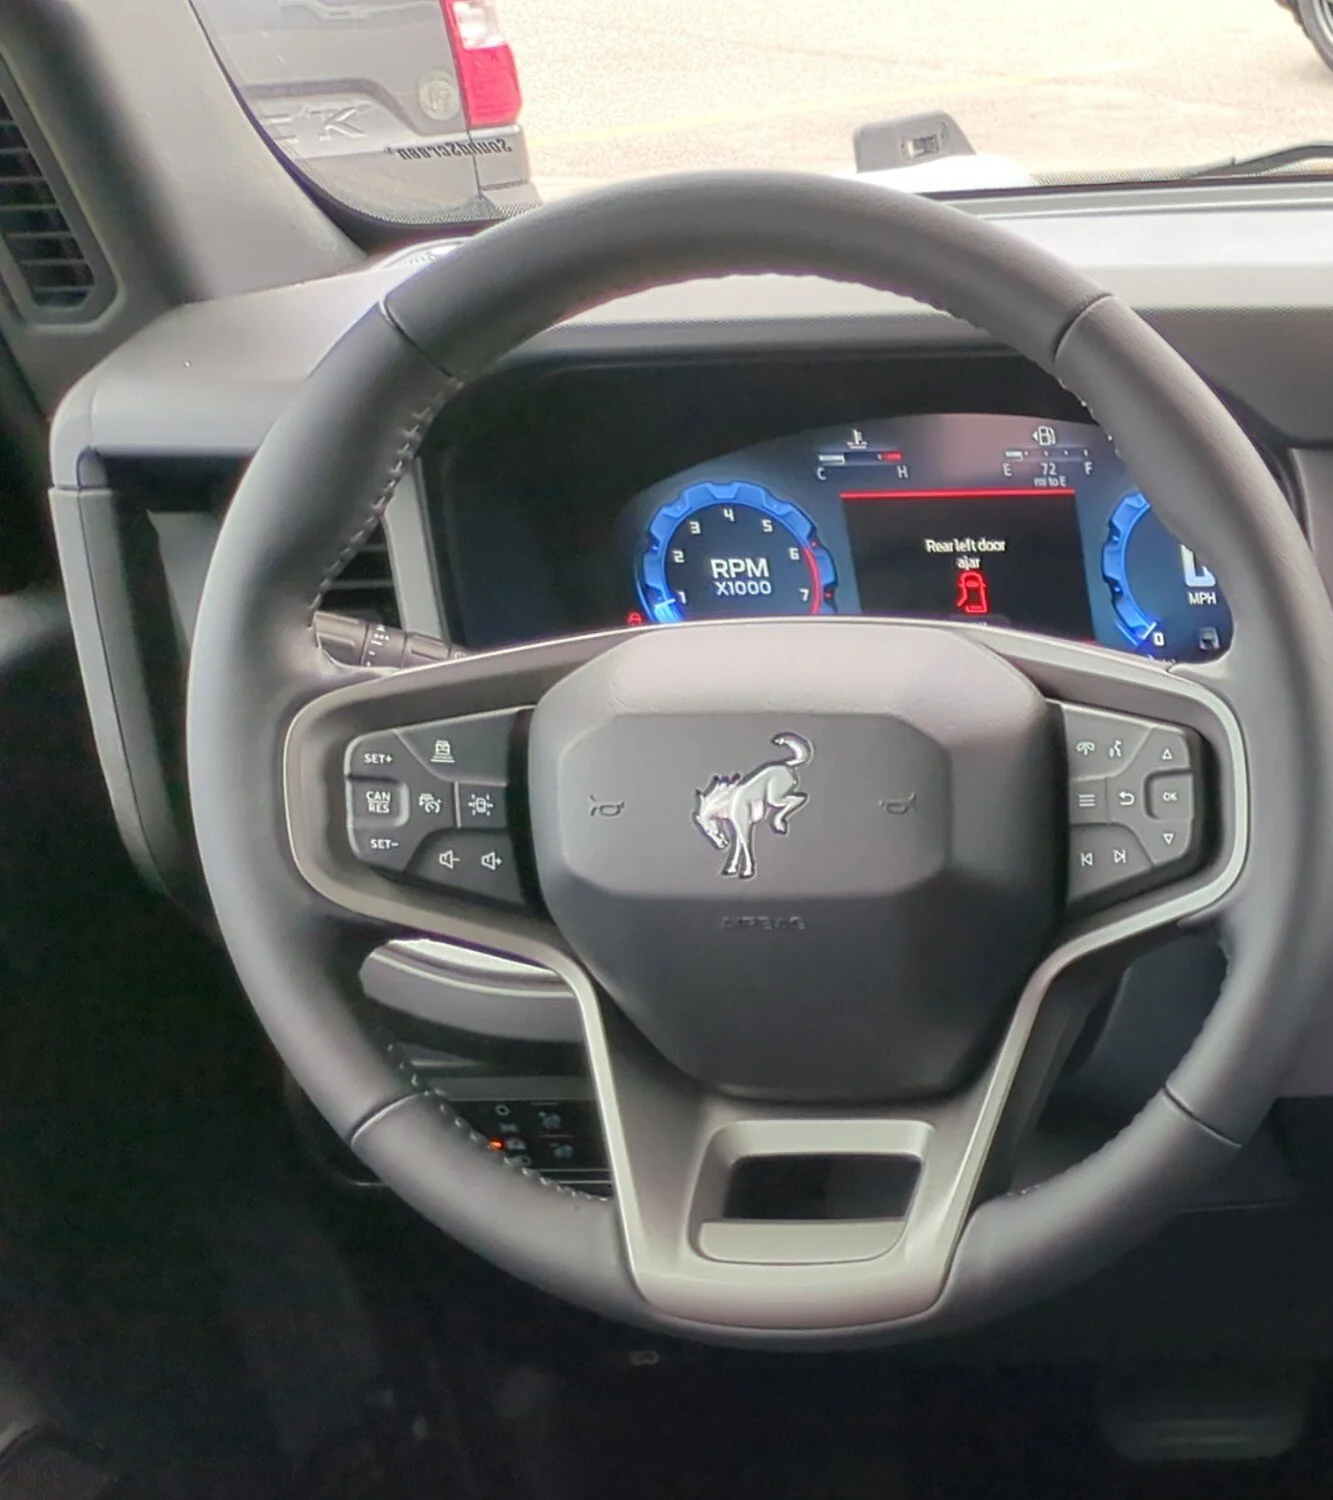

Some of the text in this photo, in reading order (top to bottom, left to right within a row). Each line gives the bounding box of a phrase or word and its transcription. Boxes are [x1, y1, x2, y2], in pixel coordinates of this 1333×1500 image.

[817, 468, 826, 480] C
[897, 467, 908, 479] H
[1003, 464, 1012, 477] E
[1040, 463, 1057, 476] 72
[1085, 462, 1092, 475] F
[1034, 475, 1067, 486] mi to E
[723, 508, 734, 521] 4
[689, 521, 701, 534] 3
[762, 519, 773, 532] 5
[925, 538, 1006, 552] Rear left door
[673, 550, 685, 563] 2
[789, 548, 800, 560] 6
[710, 558, 770, 579] RPM
[957, 556, 980, 571] ajar
[715, 581, 772, 596] X1000
[799, 589, 809, 601] 7
[678, 591, 687, 603] 1
[1188, 591, 1217, 605] MPH
[366, 791, 391, 801] CAN
[1163, 792, 1177, 801] OK
[368, 803, 390, 814] RES
